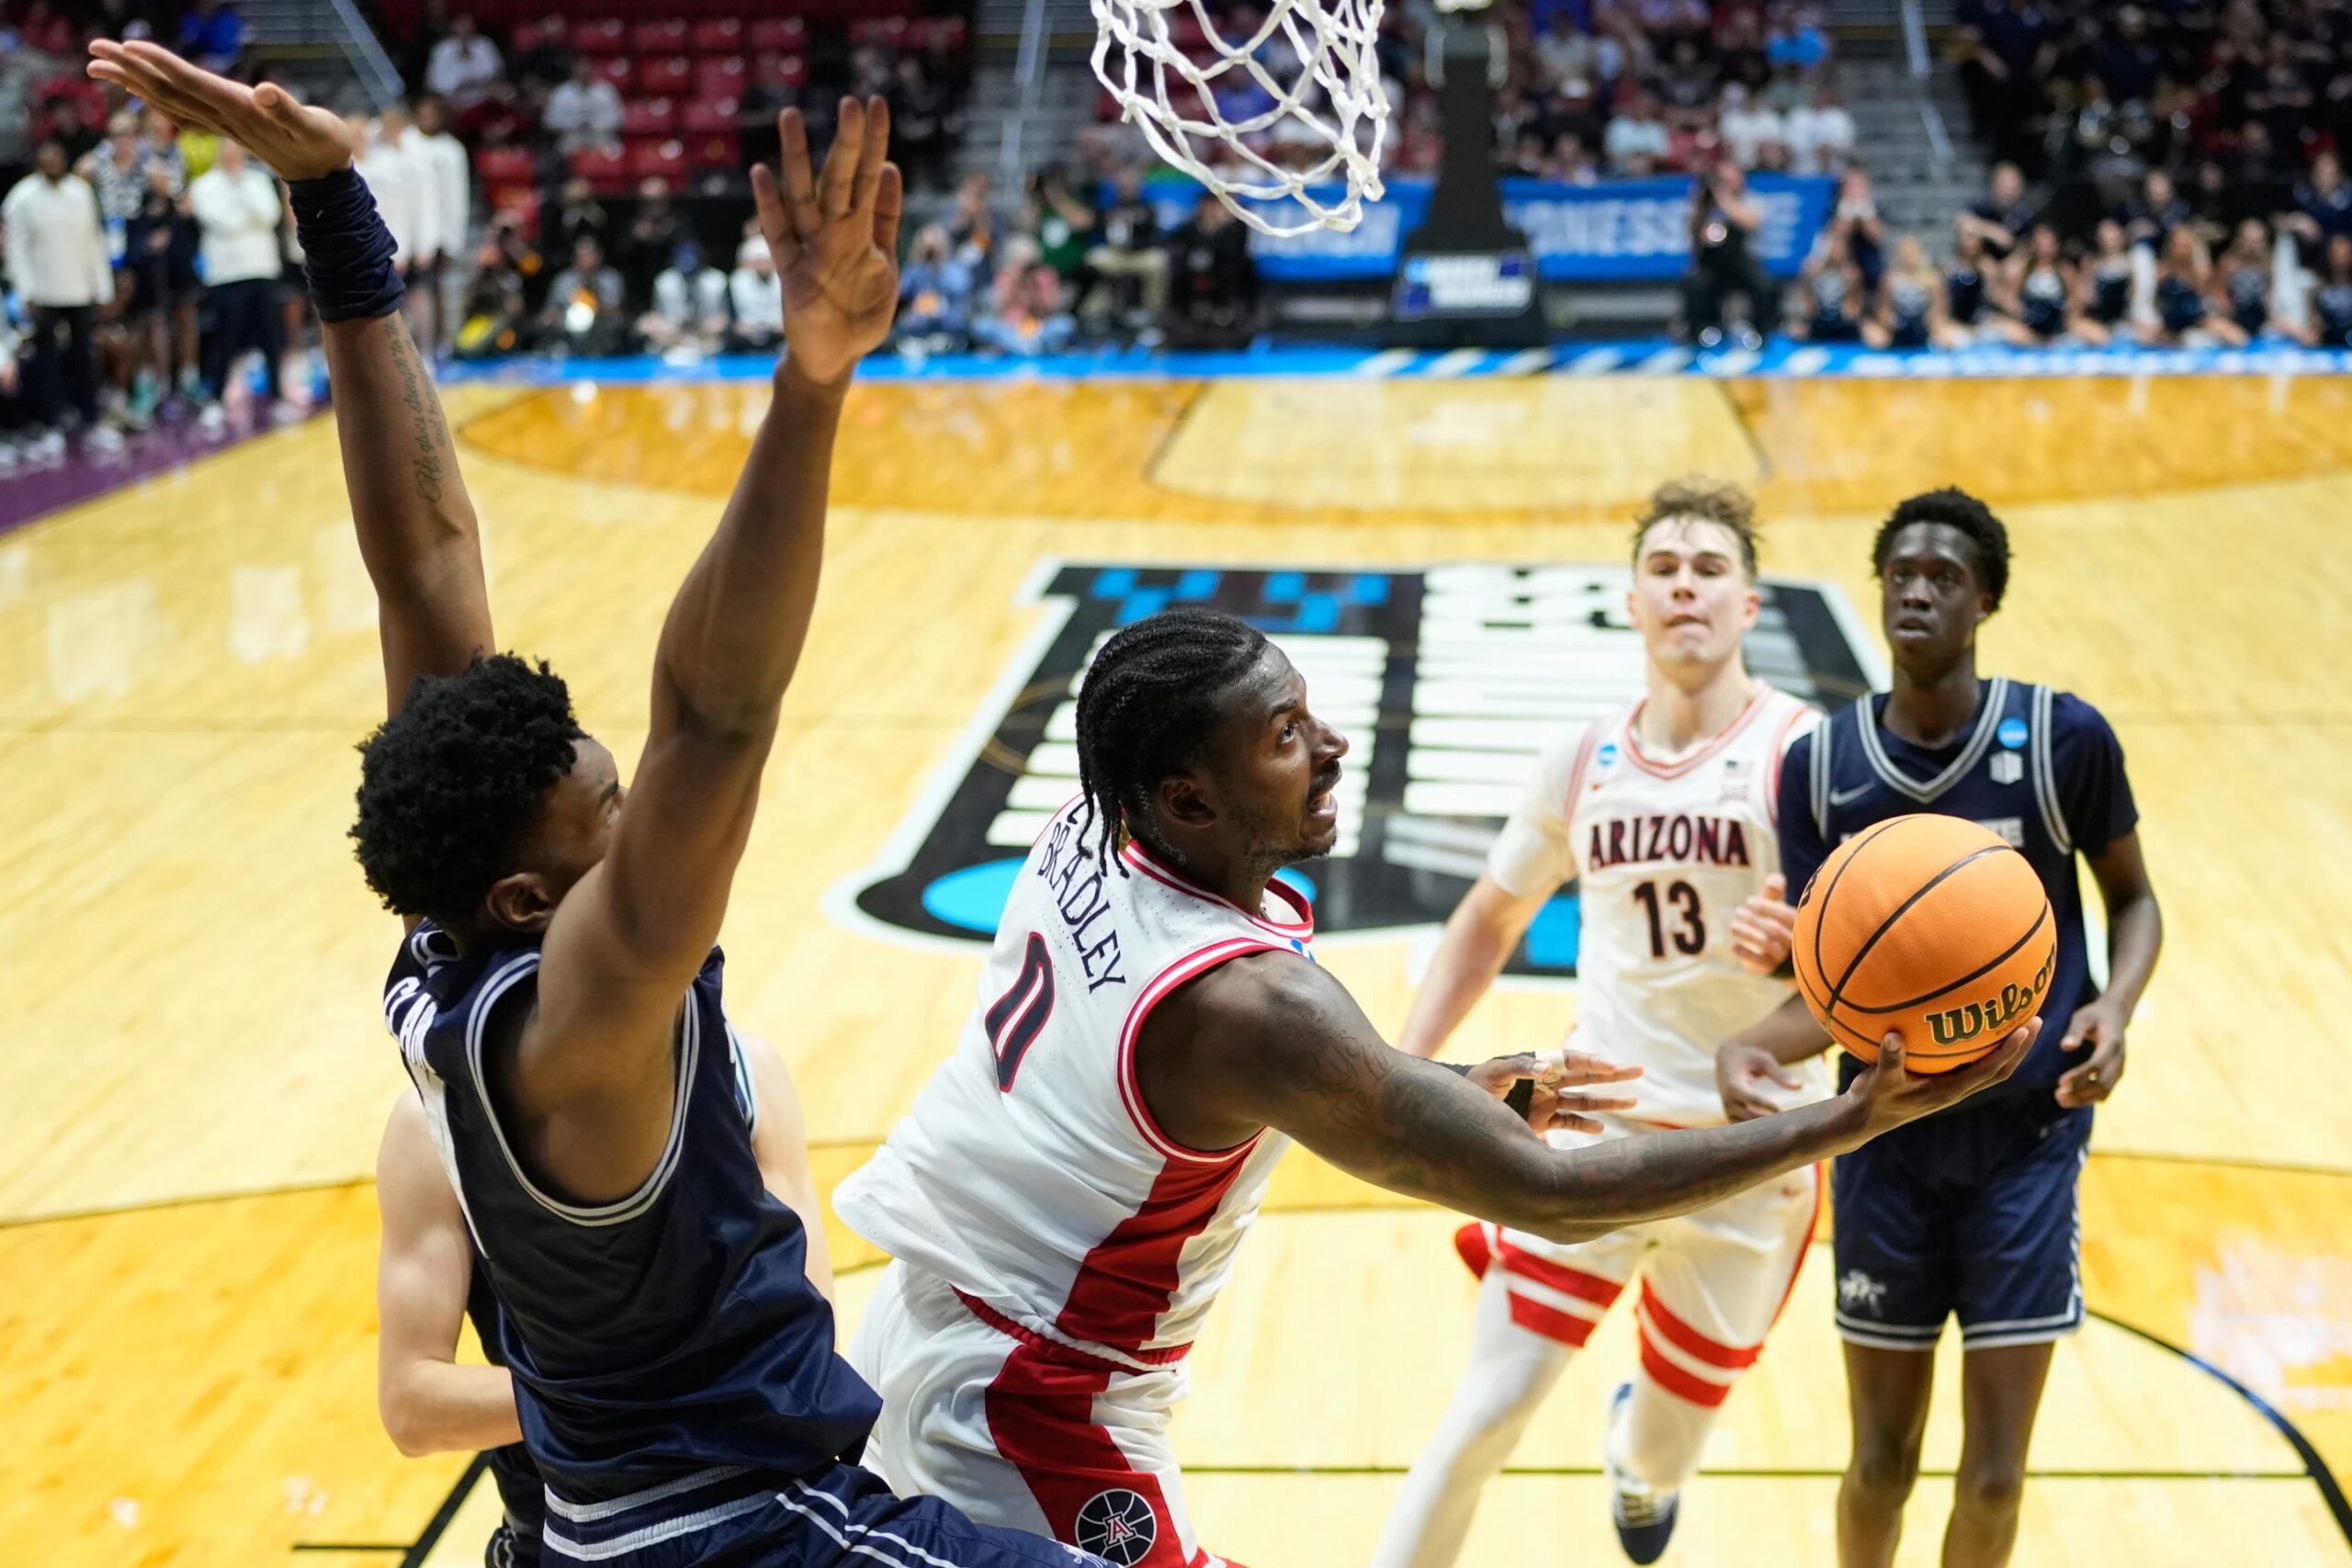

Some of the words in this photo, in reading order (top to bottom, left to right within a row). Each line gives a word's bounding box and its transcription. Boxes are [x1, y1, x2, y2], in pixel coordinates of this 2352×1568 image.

[1589, 815, 1750, 873] ARIZONA
[1037, 822, 1125, 994] BRADLEY
[1634, 879, 1706, 959] 13
[985, 931, 1055, 1092] 0
[1924, 942, 2055, 1045] Wilson
[1105, 1513, 1136, 1547] A
